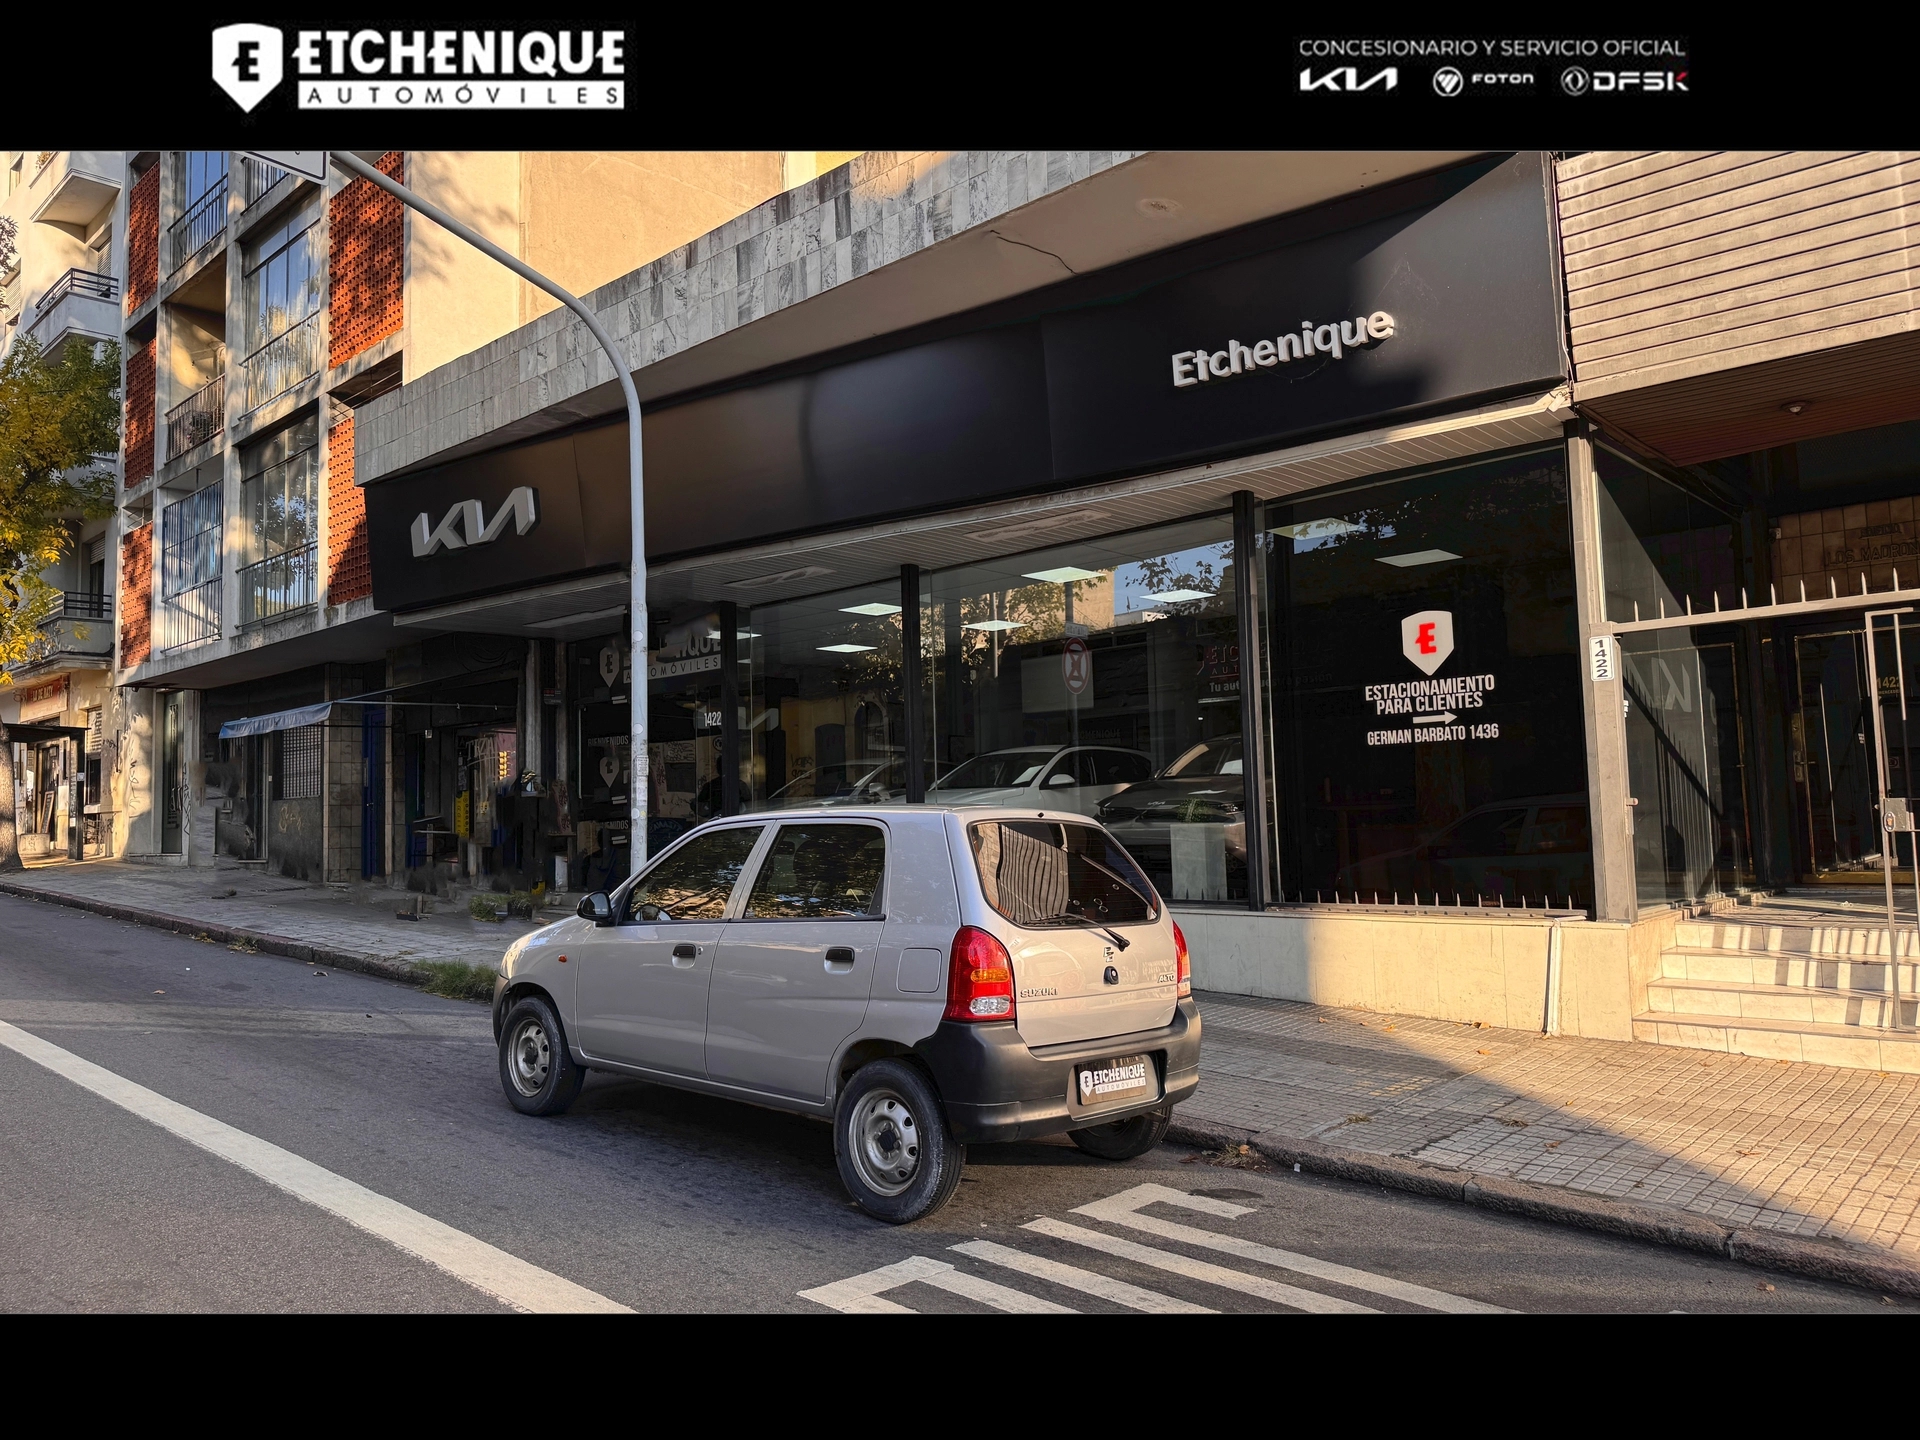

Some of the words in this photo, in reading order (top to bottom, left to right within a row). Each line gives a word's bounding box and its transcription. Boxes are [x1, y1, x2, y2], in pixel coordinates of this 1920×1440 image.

[1172, 311, 1395, 387] Etchenique
[410, 486, 535, 557] KIA
[626, 656, 719, 681] AOMÓVILES
[1594, 639, 1608, 678] 1422
[1365, 674, 1495, 701] ESTACIONAMIENTO
[1377, 697, 1413, 715] PARA
[1416, 691, 1483, 712] CLIENTES
[704, 711, 722, 727] 1422
[1367, 729, 1412, 746] GERMAN
[1414, 725, 1466, 743] BARBATO
[1469, 723, 1500, 740] 1436
[1020, 987, 1059, 999] SUZUKI
[1093, 1063, 1145, 1085] ETCHENIQUE
